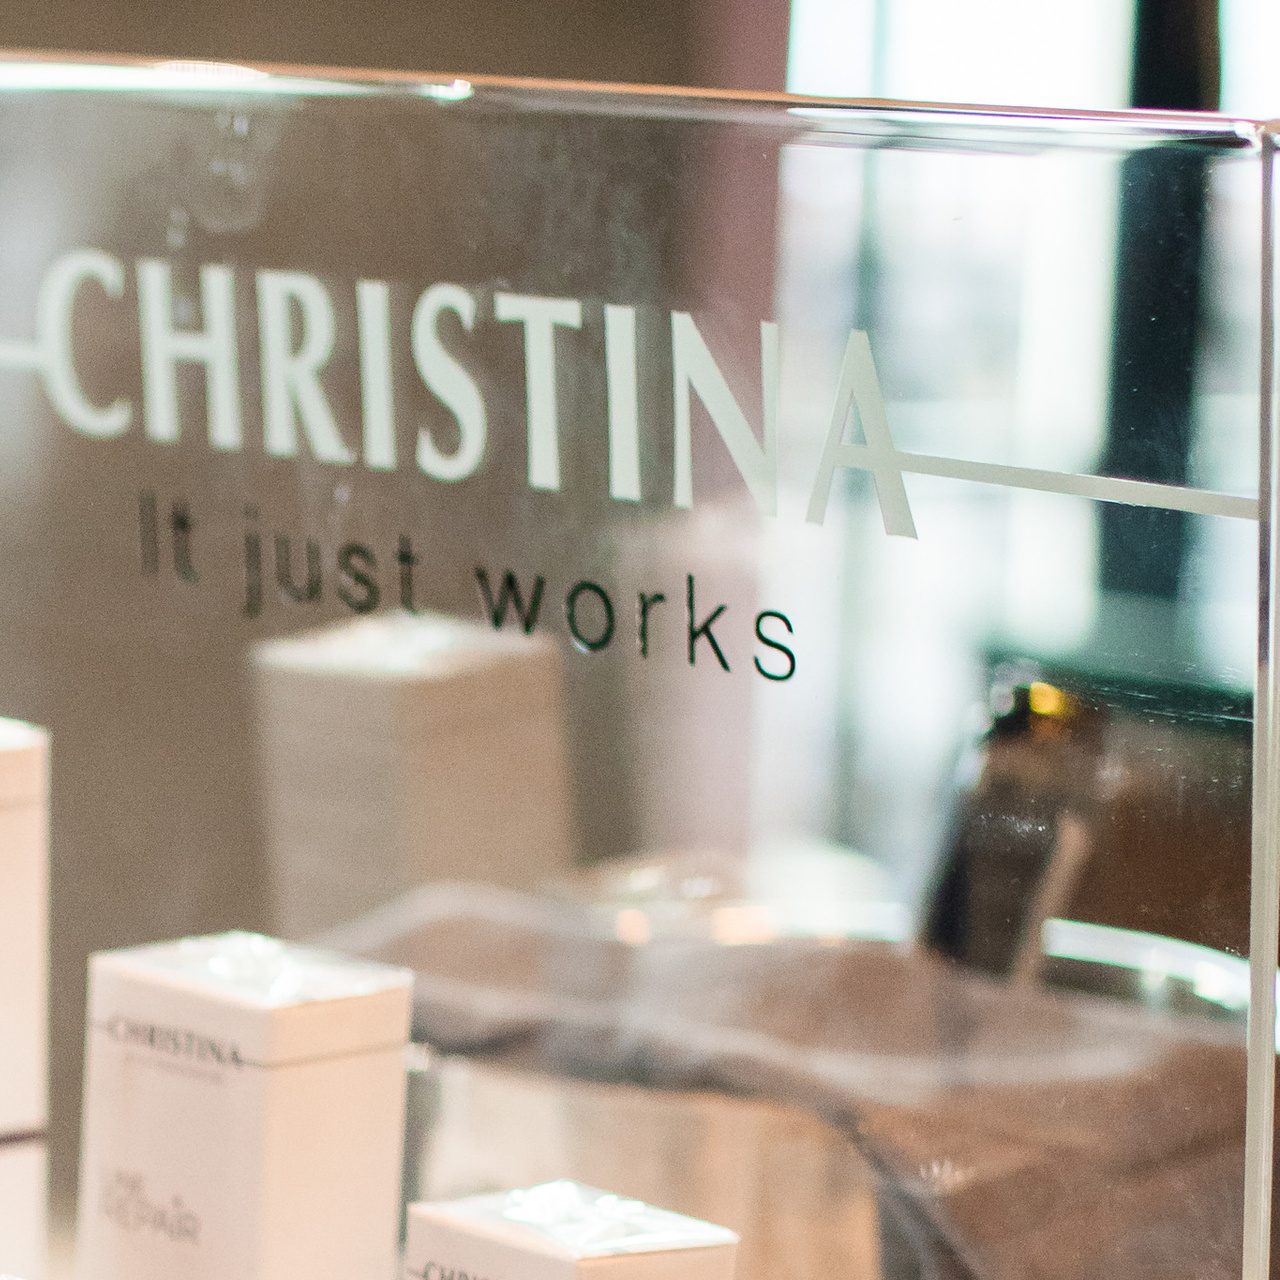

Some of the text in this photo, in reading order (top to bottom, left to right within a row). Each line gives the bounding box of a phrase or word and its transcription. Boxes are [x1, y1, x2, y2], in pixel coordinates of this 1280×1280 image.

[37, 248, 919, 541] CHRISTINA
[137, 488, 800, 682] It just works
